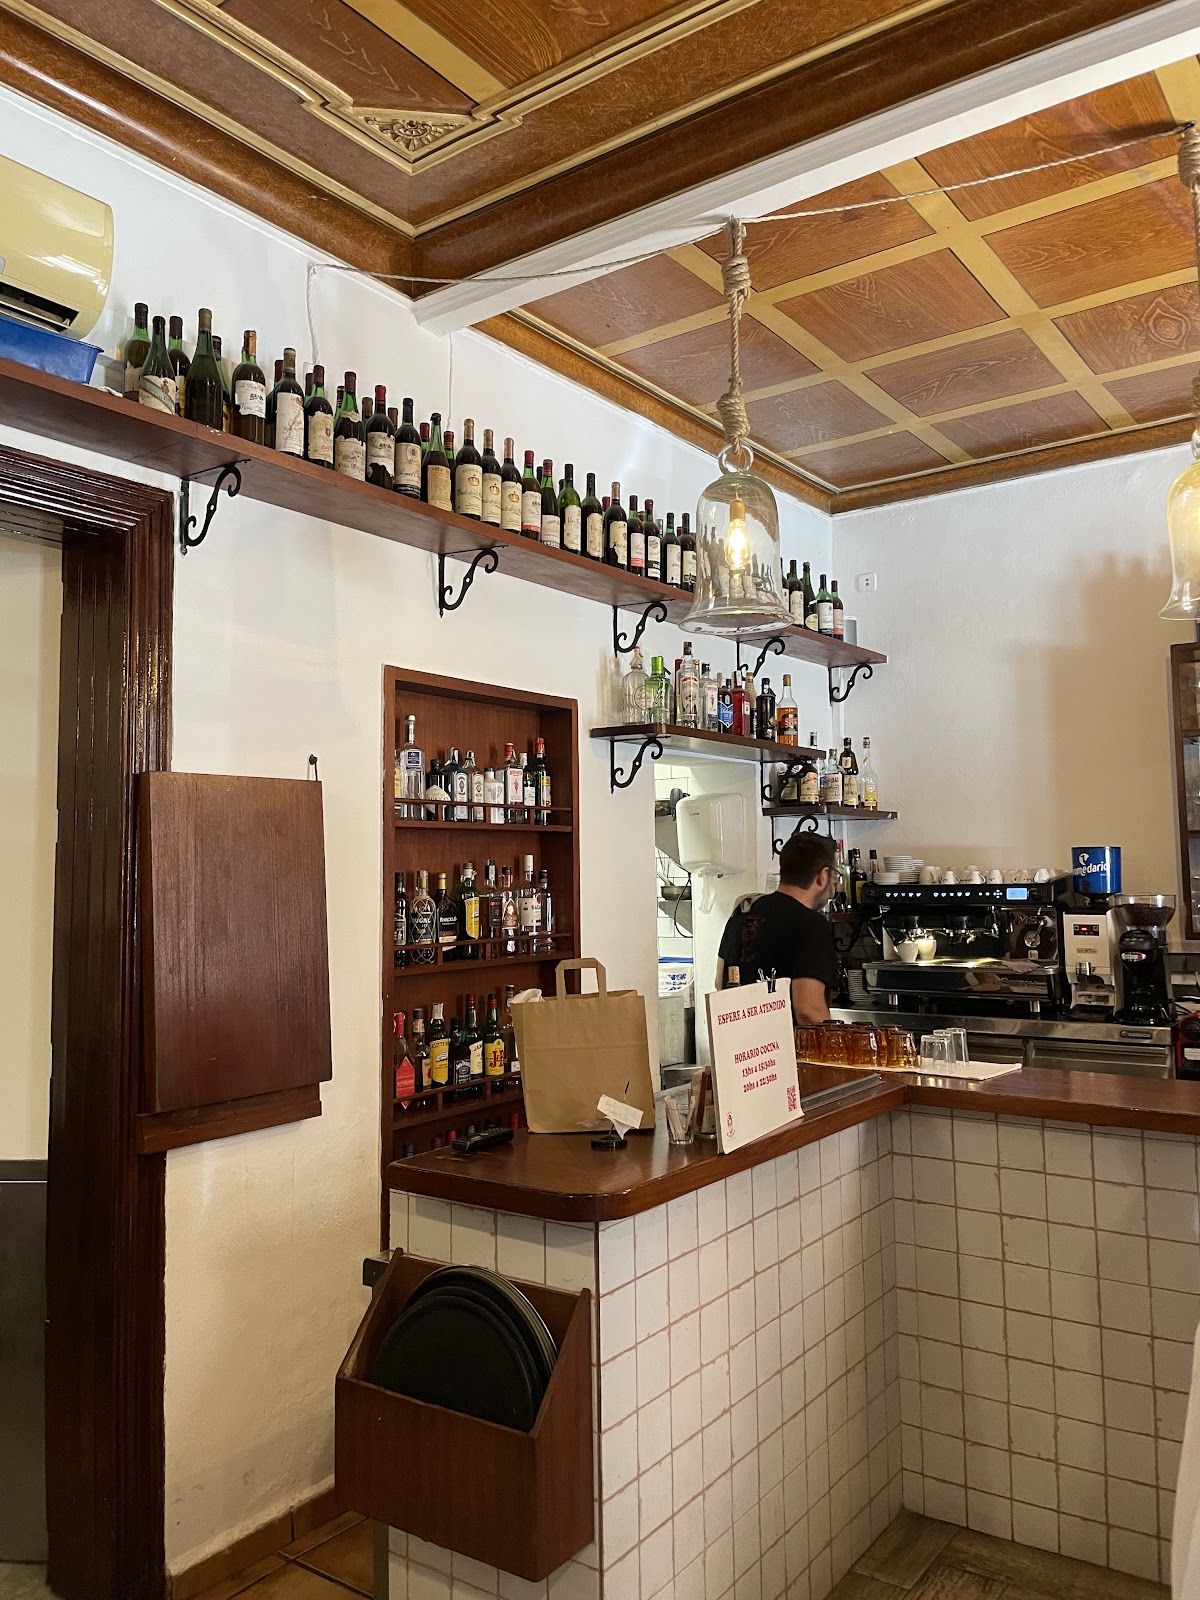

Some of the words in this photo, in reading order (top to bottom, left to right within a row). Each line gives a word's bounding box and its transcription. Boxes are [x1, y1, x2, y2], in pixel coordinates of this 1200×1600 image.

[717, 1010, 741, 1025] ESPERE
[742, 1009, 747, 1020] A
[747, 1006, 758, 1018] SER
[759, 999, 786, 1014] ATENDIDO
[734, 1047, 760, 1064] HORARIO
[760, 1041, 780, 1055] COCINA
[742, 1066, 754, 1077] 13hs
[758, 1058, 776, 1072] 15:30hs
[743, 1081, 755, 1093] 20hs
[759, 1073, 777, 1087] 22:30hs
